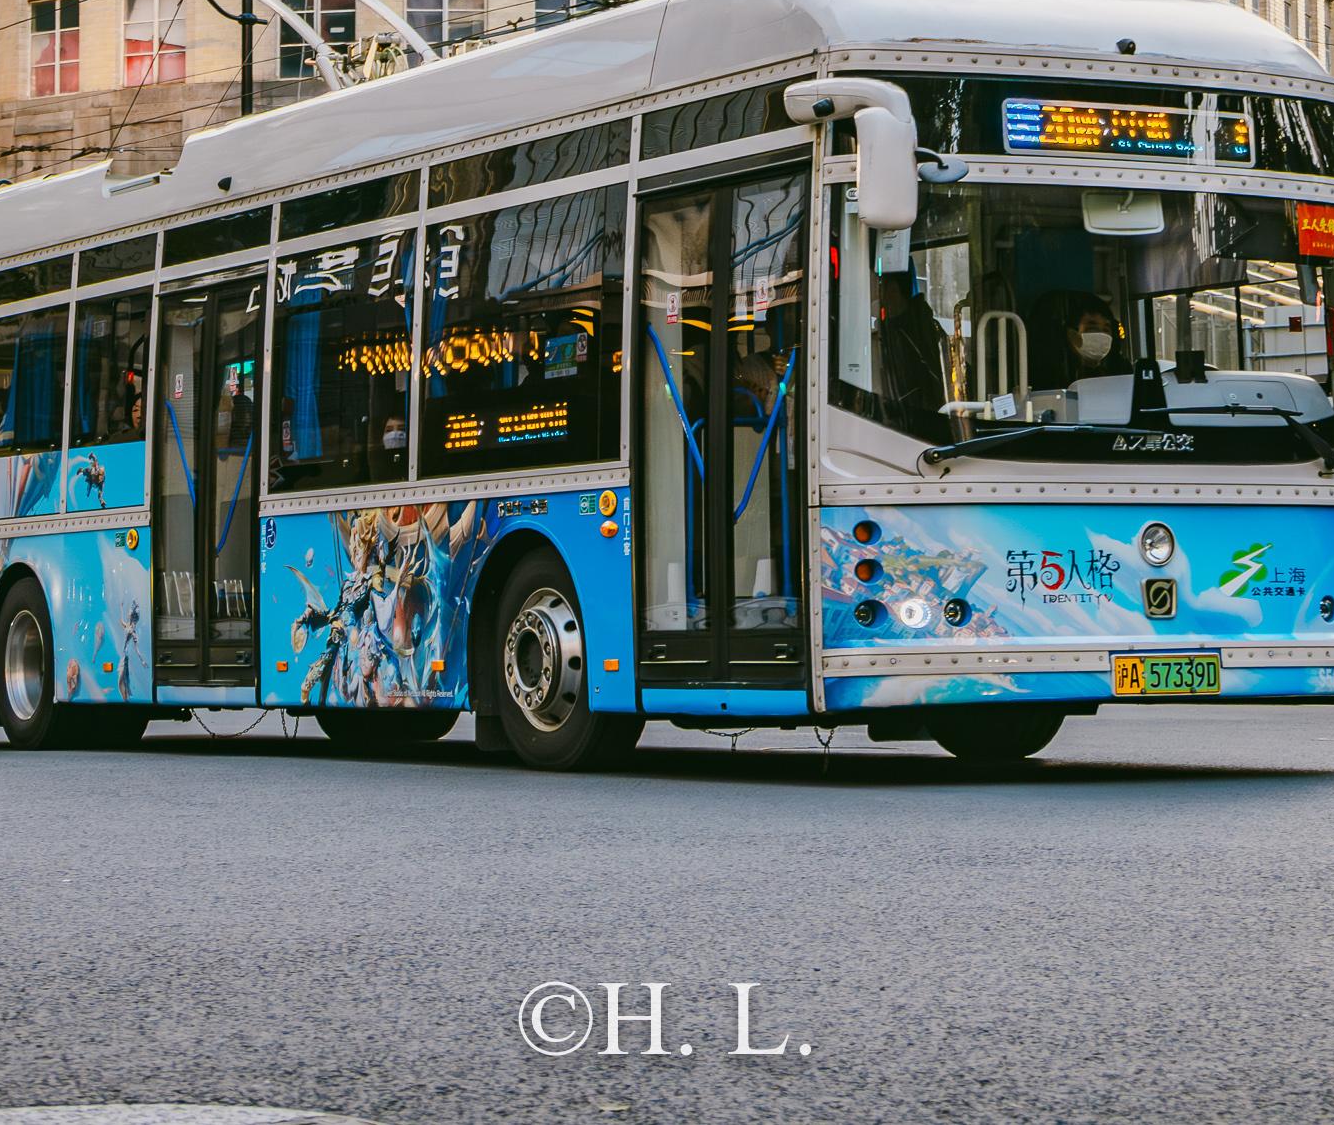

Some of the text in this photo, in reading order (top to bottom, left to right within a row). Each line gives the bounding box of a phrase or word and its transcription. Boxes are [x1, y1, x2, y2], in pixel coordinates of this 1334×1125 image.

[1006, 550, 1120, 607] 第5人格
[1269, 567, 1307, 585] 上海
[1251, 586, 1306, 597] 公共交通卡
